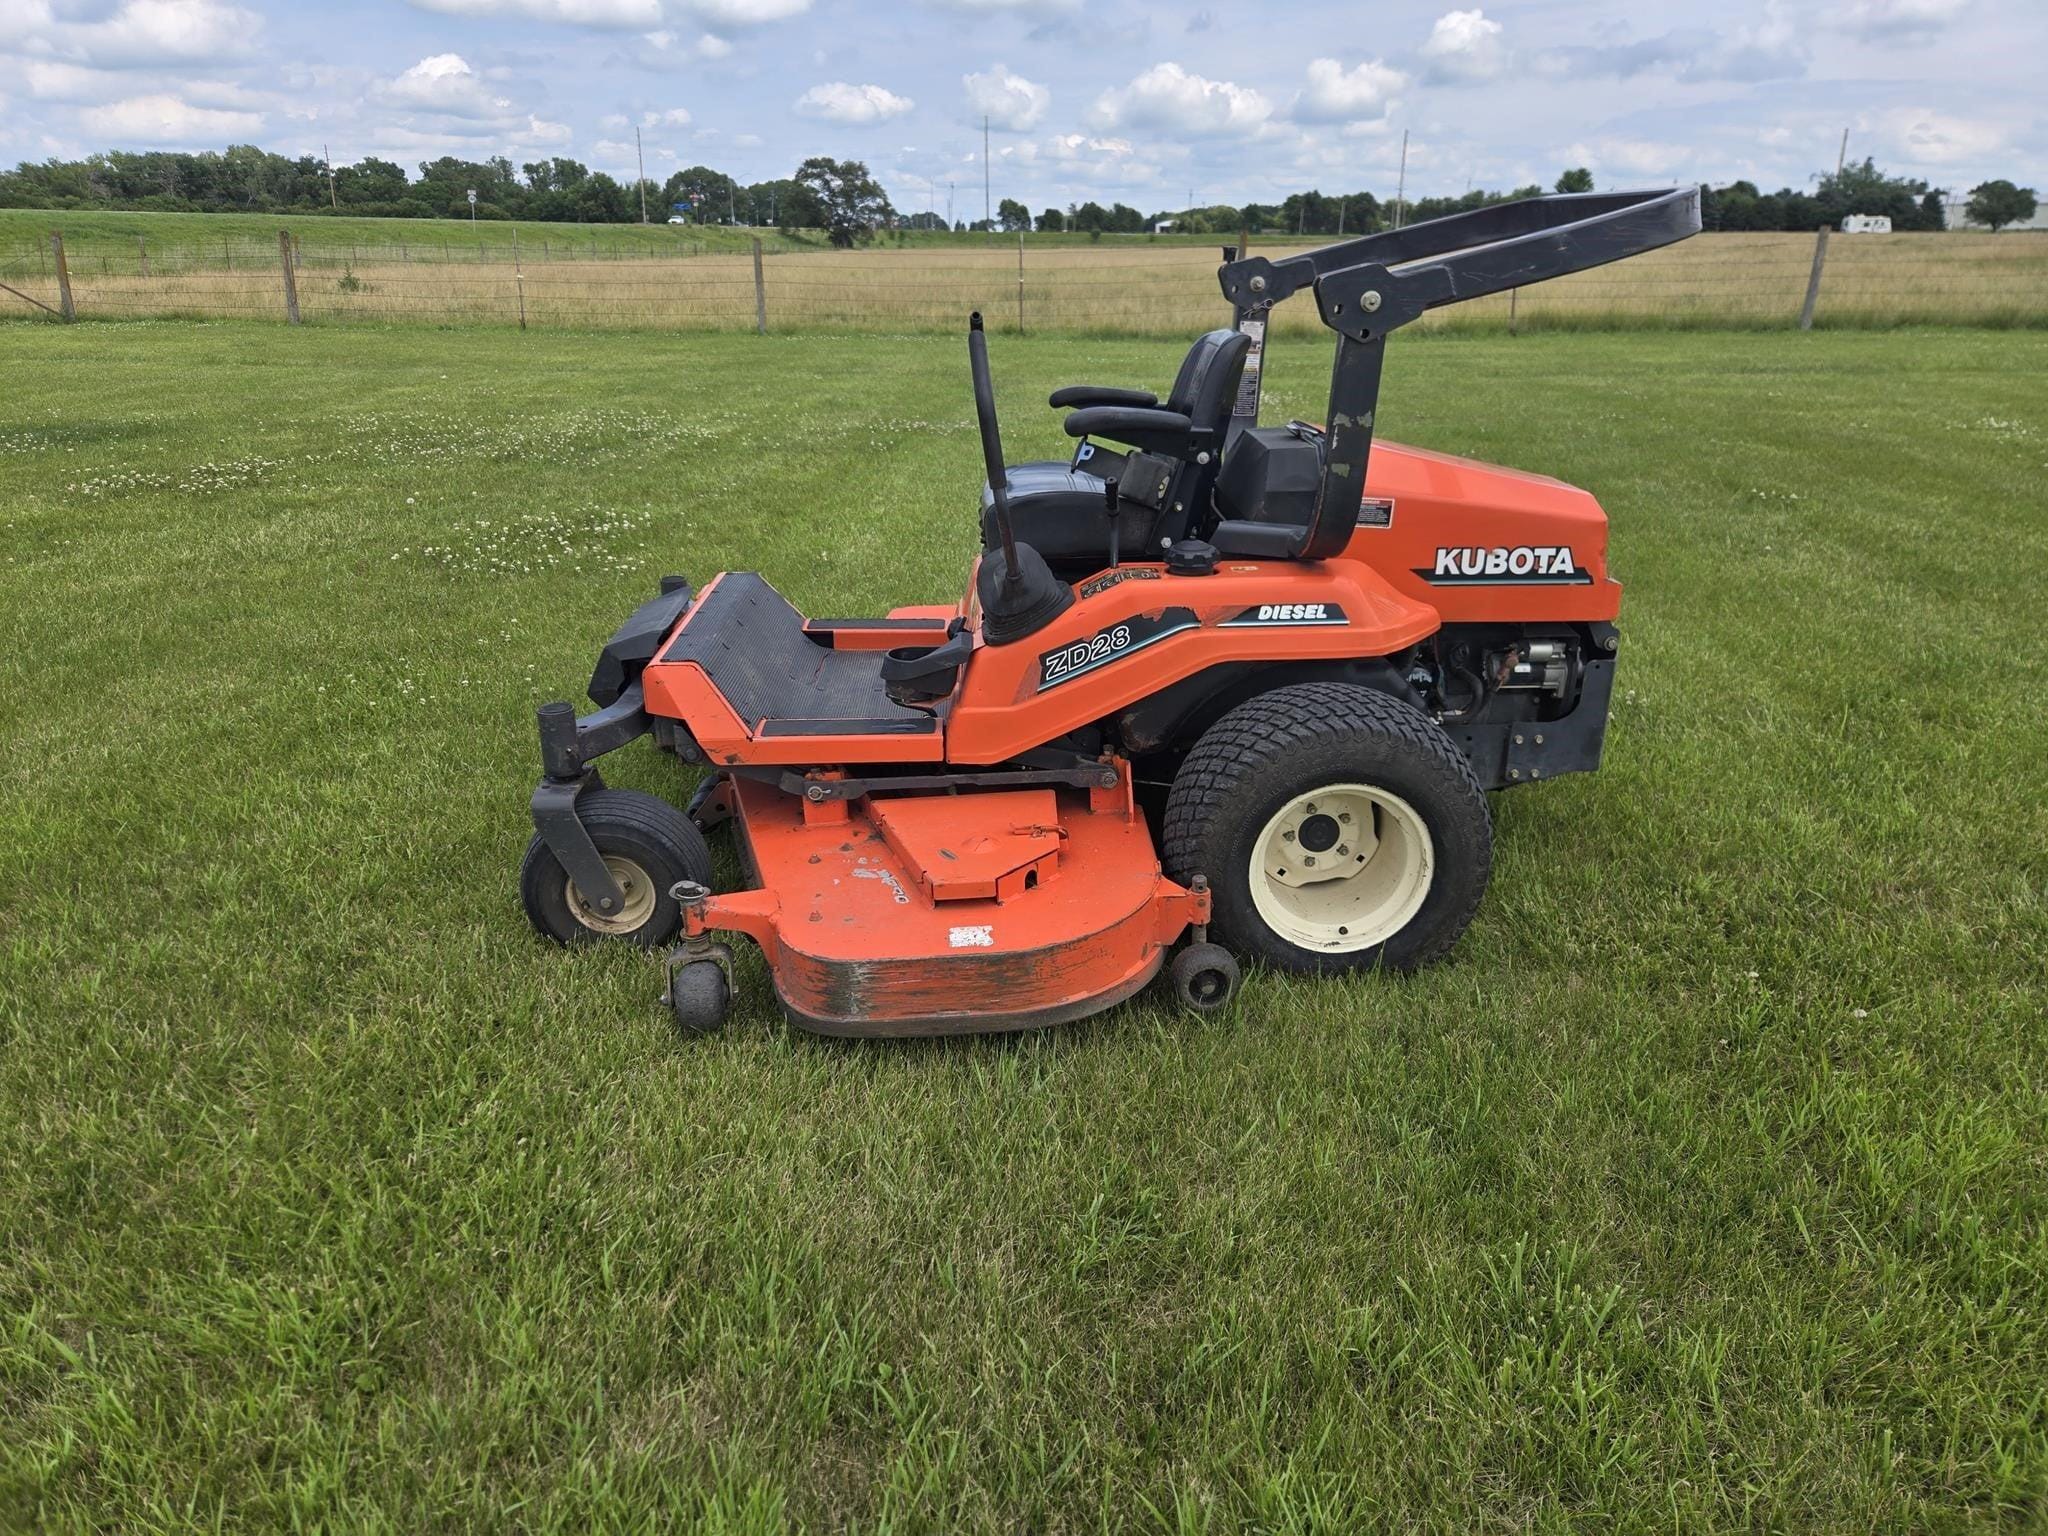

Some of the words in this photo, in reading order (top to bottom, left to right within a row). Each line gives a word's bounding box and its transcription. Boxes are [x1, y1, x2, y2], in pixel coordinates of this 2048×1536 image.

[1435, 547, 1575, 575] KUBOTA
[1258, 604, 1327, 620] DIESEL
[1045, 625, 1131, 681] ZD28
